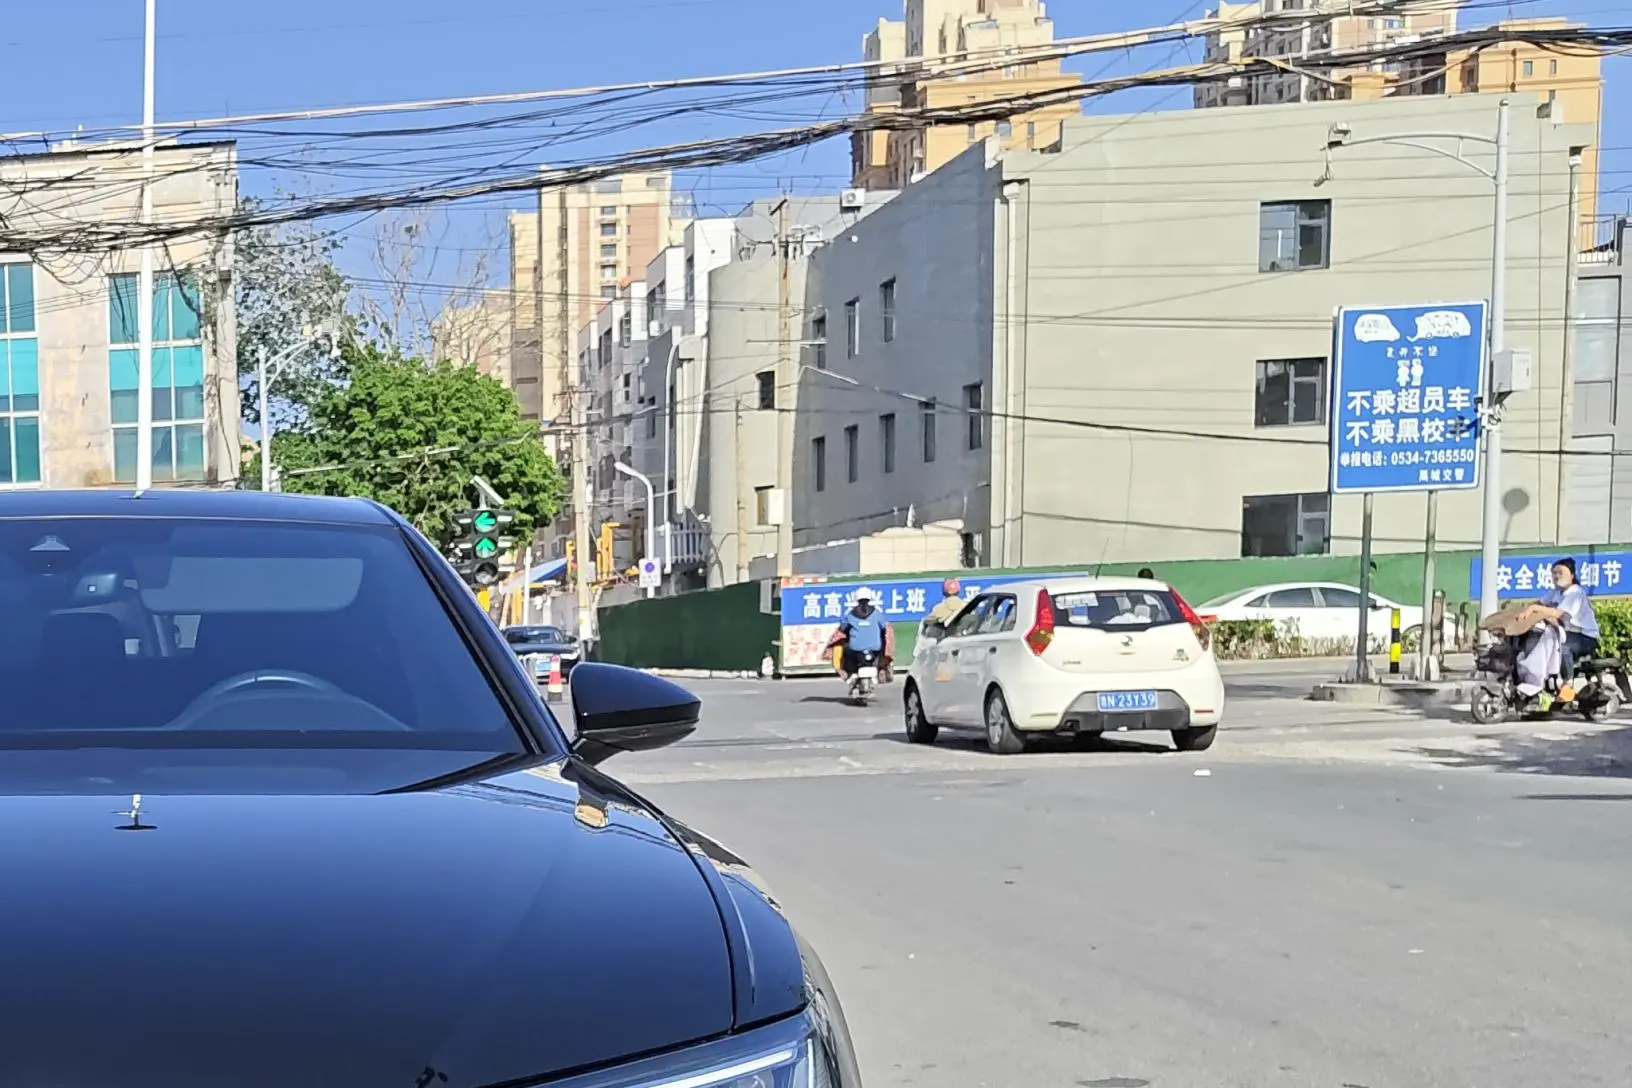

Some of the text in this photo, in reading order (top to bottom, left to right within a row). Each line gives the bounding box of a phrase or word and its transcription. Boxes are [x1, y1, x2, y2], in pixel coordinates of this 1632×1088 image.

[1346, 386, 1471, 416] 不乘超员车
[1345, 416, 1470, 447] 不乘黑校车
[1496, 560, 1622, 591] 安全始细节
